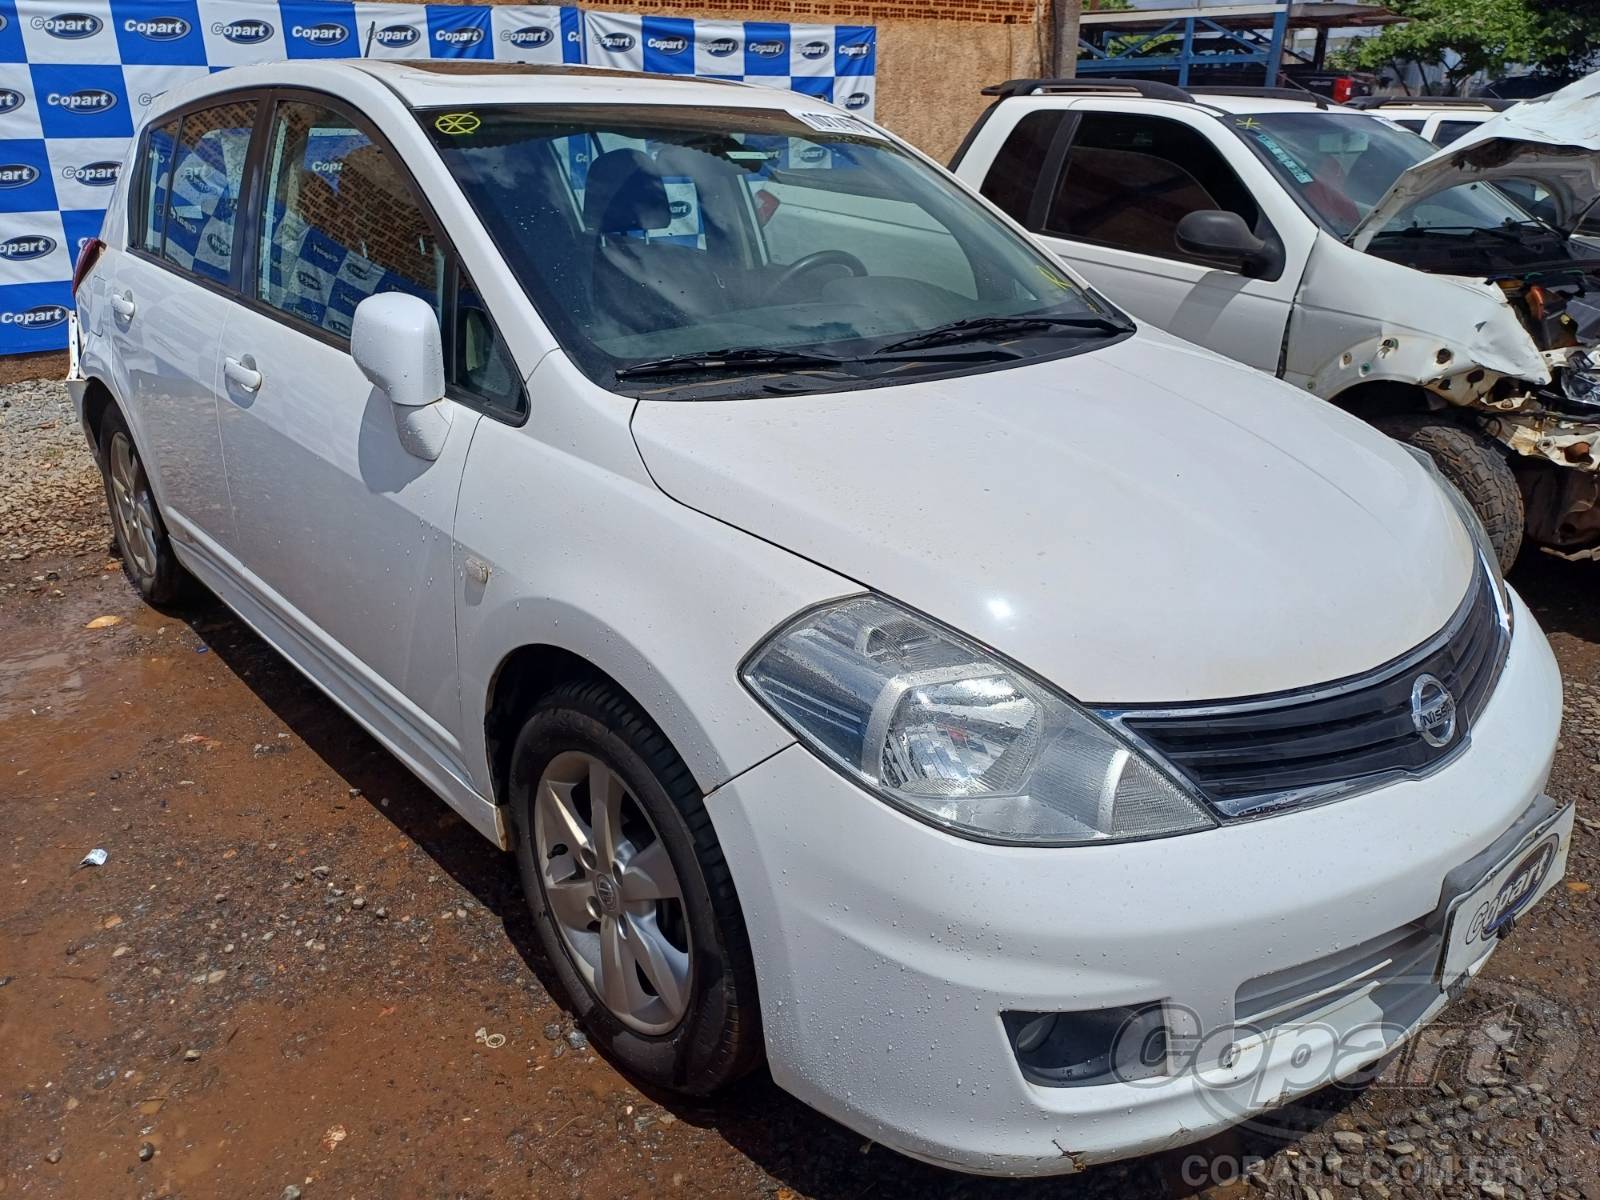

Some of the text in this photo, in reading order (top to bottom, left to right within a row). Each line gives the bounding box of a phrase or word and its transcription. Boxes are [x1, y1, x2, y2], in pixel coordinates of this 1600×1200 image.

[31, 16, 93, 32] Copart
[124, 19, 182, 34] Copart
[211, 22, 265, 36] Copart
[292, 26, 342, 39] Copart
[435, 31, 478, 41] Copart
[501, 29, 546, 42] Copart
[592, 32, 630, 47] Copart
[647, 38, 683, 50] Copart
[701, 41, 733, 52] Copart
[749, 42, 781, 53] Copart
[838, 44, 867, 55] Copart
[47, 93, 108, 108] Copart
[62, 166, 120, 181] Copart
[1, 310, 62, 326] Copart
[1466, 851, 1548, 945] Copart
